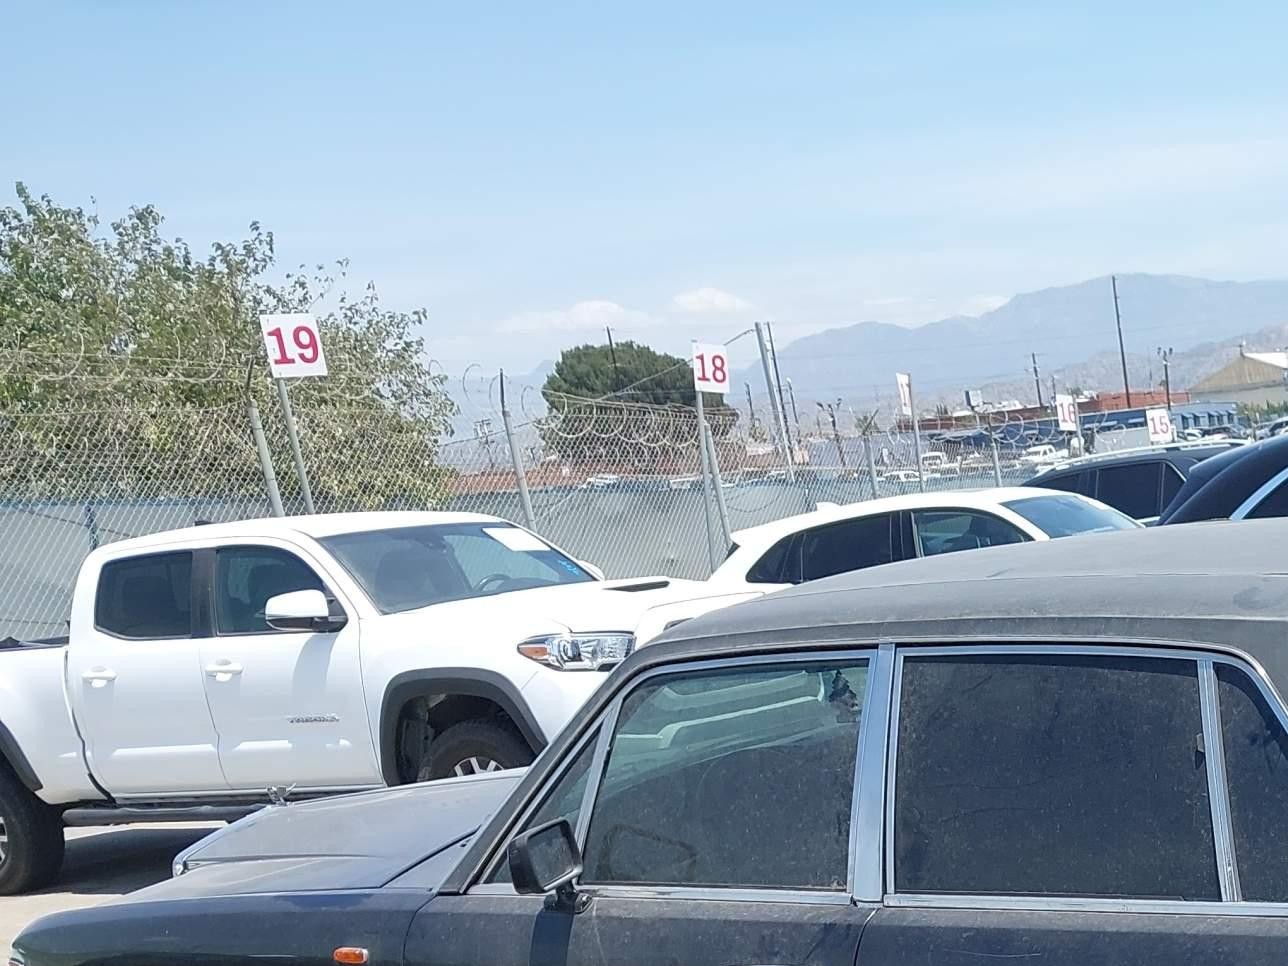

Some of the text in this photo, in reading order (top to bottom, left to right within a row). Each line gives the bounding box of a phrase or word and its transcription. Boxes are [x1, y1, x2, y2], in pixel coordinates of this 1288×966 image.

[267, 326, 319, 365] 19
[695, 353, 727, 383] 18
[1149, 415, 1169, 435] 15
